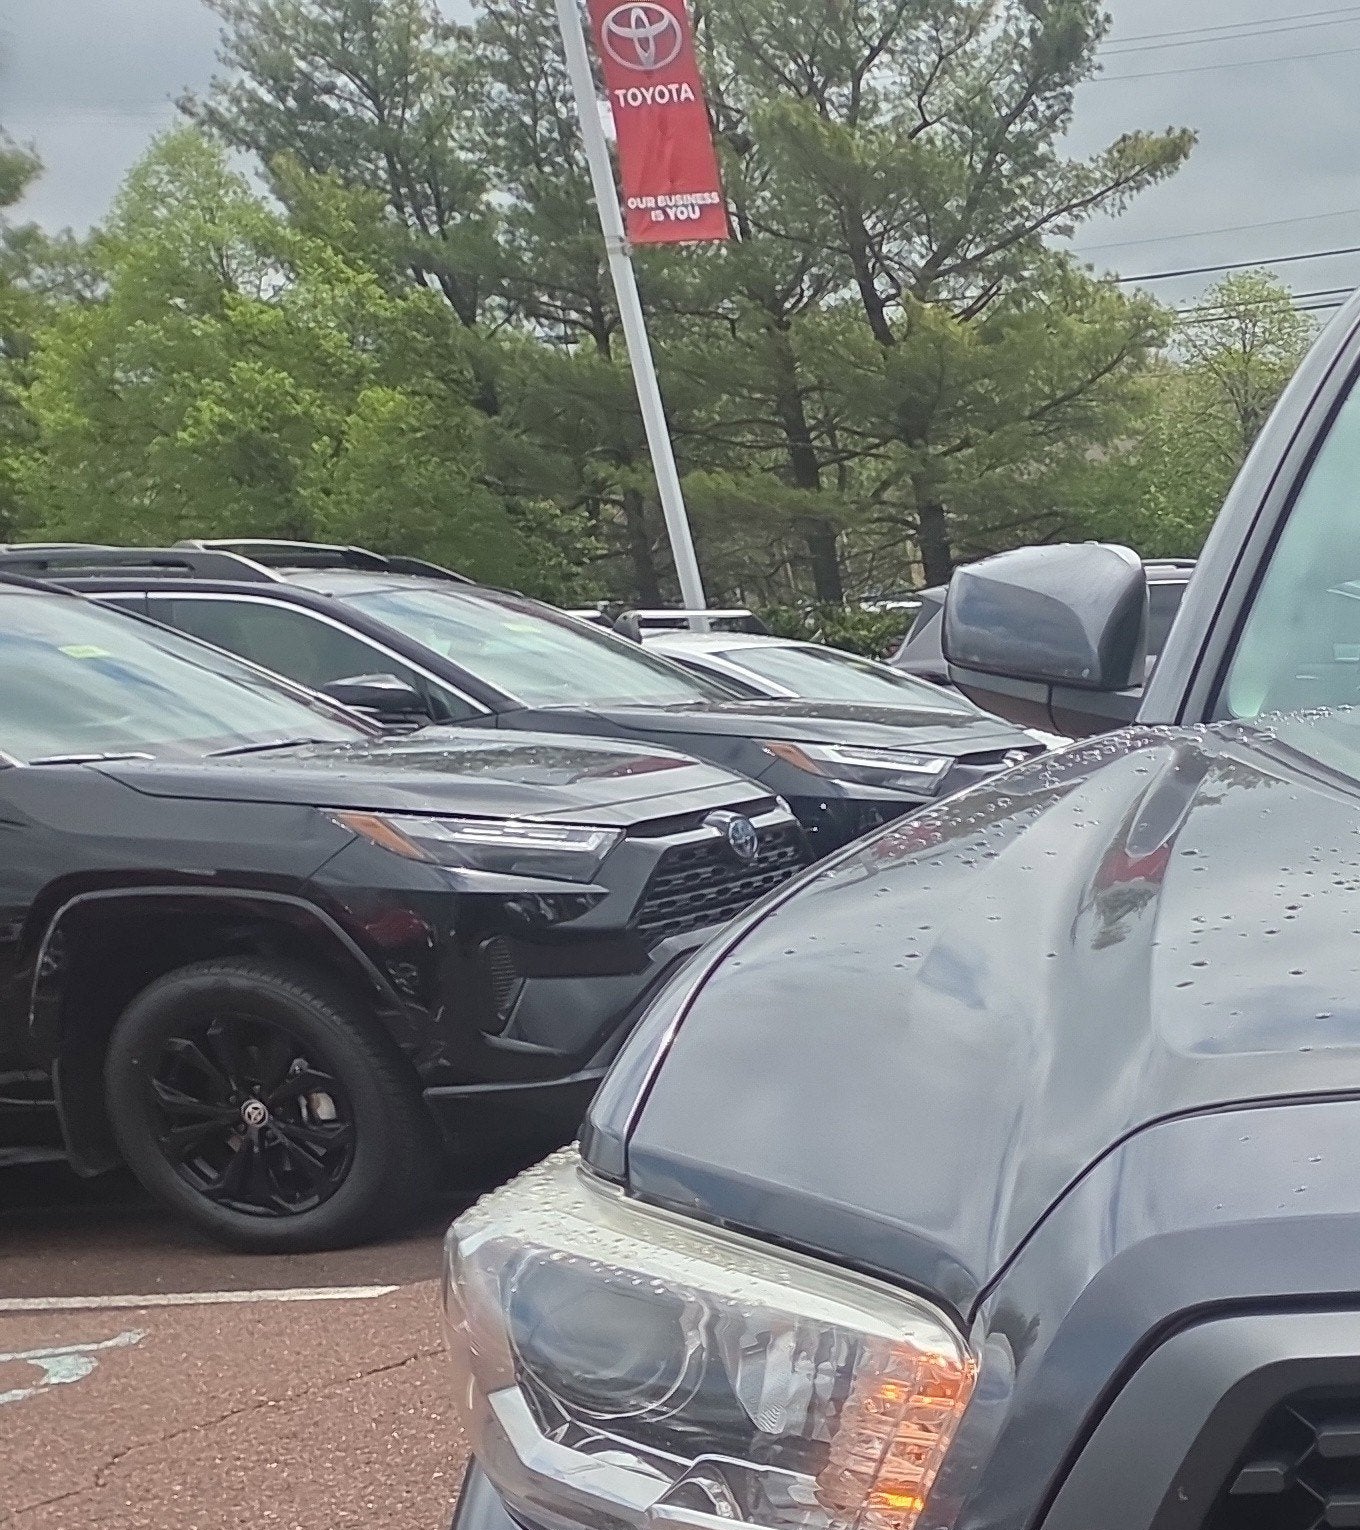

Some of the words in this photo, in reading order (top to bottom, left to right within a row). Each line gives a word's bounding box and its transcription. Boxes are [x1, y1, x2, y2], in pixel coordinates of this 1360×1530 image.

[614, 82, 695, 108] TOYOTA
[627, 196, 656, 210] OUR
[657, 191, 720, 207] BUSINESS
[651, 210, 664, 221] IS
[667, 203, 701, 220] YOU
